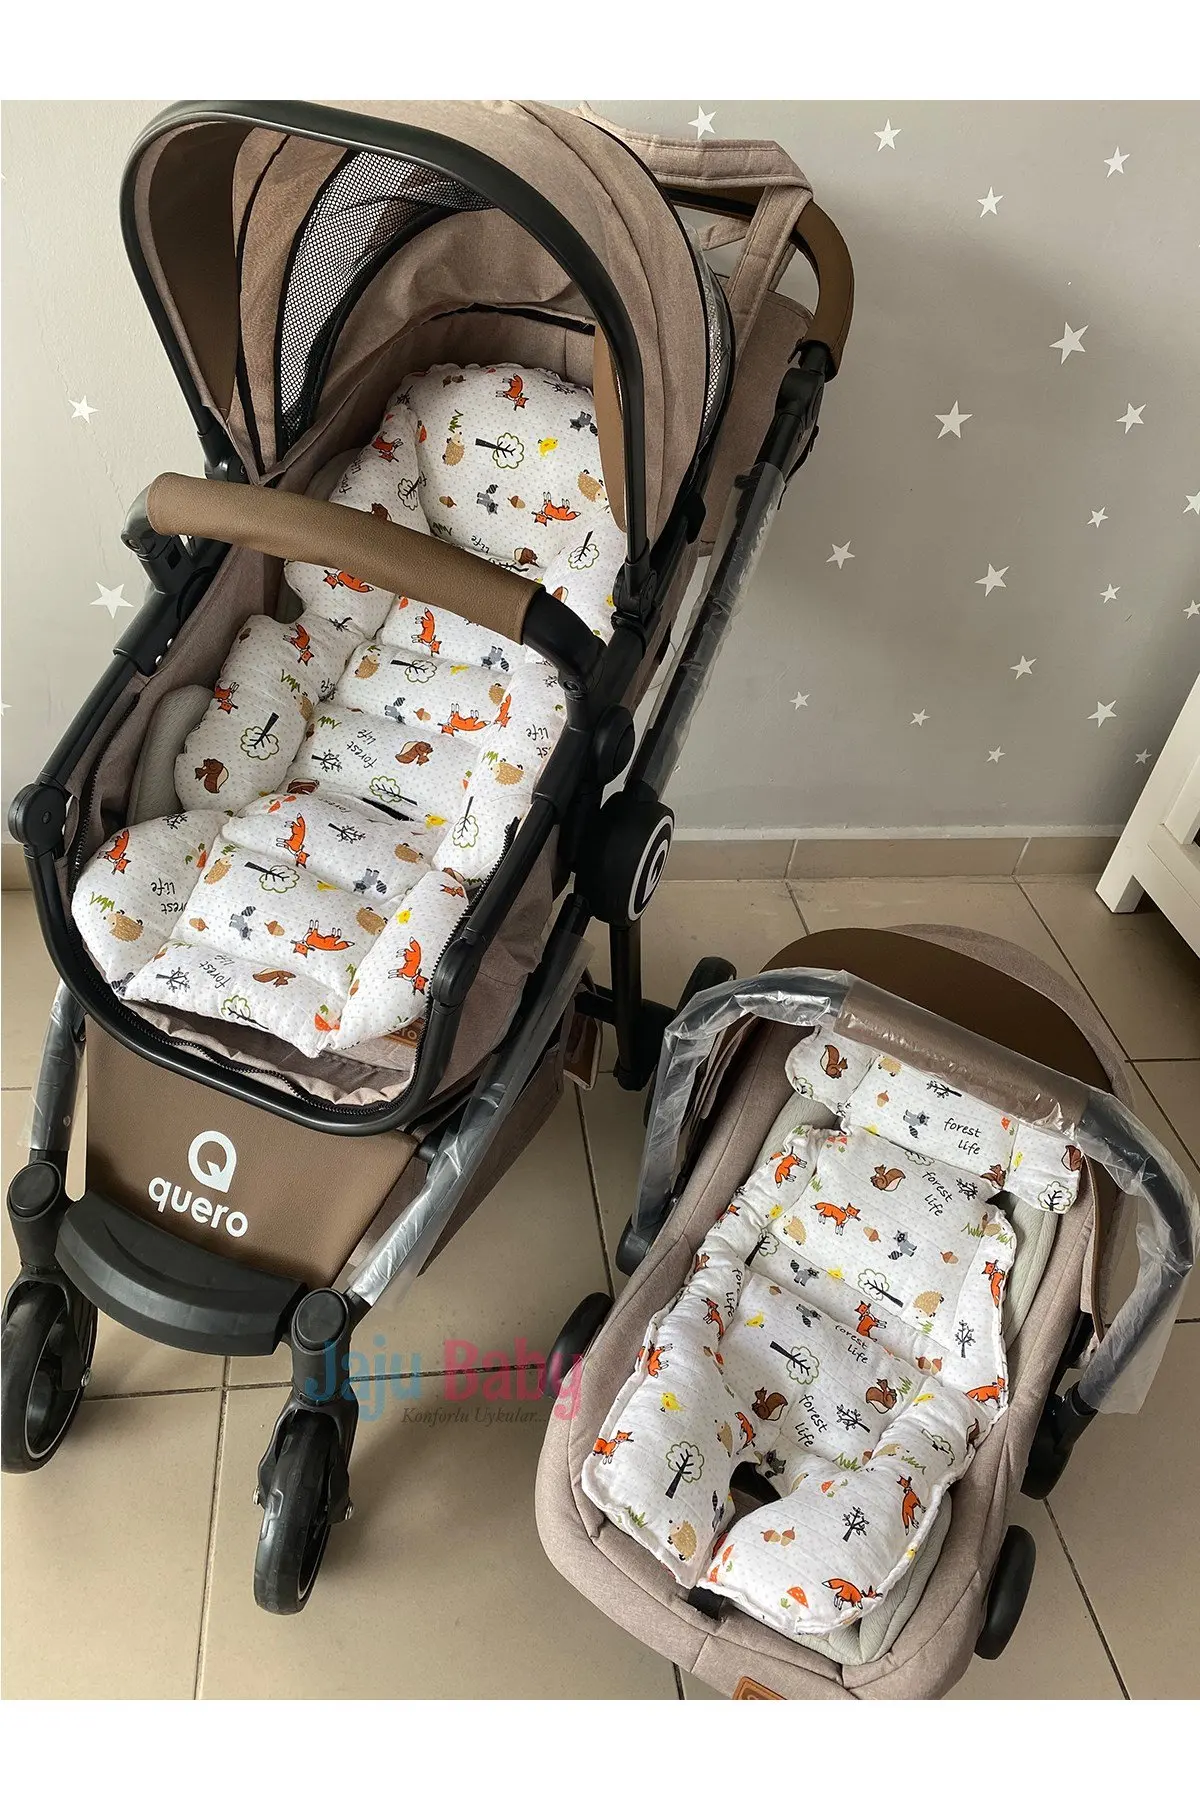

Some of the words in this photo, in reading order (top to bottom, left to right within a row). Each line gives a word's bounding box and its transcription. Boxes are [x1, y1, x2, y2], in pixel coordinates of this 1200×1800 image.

[357, 729, 376, 745] life
[525, 724, 549, 741] life
[346, 741, 377, 769] forest
[151, 878, 175, 896] life
[199, 961, 232, 989] forest
[943, 1117, 982, 1138] forest
[958, 1139, 980, 1156] life
[921, 1171, 953, 1203] forest
[148, 1176, 249, 1238] quero
[924, 1193, 944, 1217] life
[724, 1292, 736, 1318] life
[847, 1344, 869, 1364] life
[798, 1394, 828, 1434] forest
[794, 1422, 815, 1448] life
